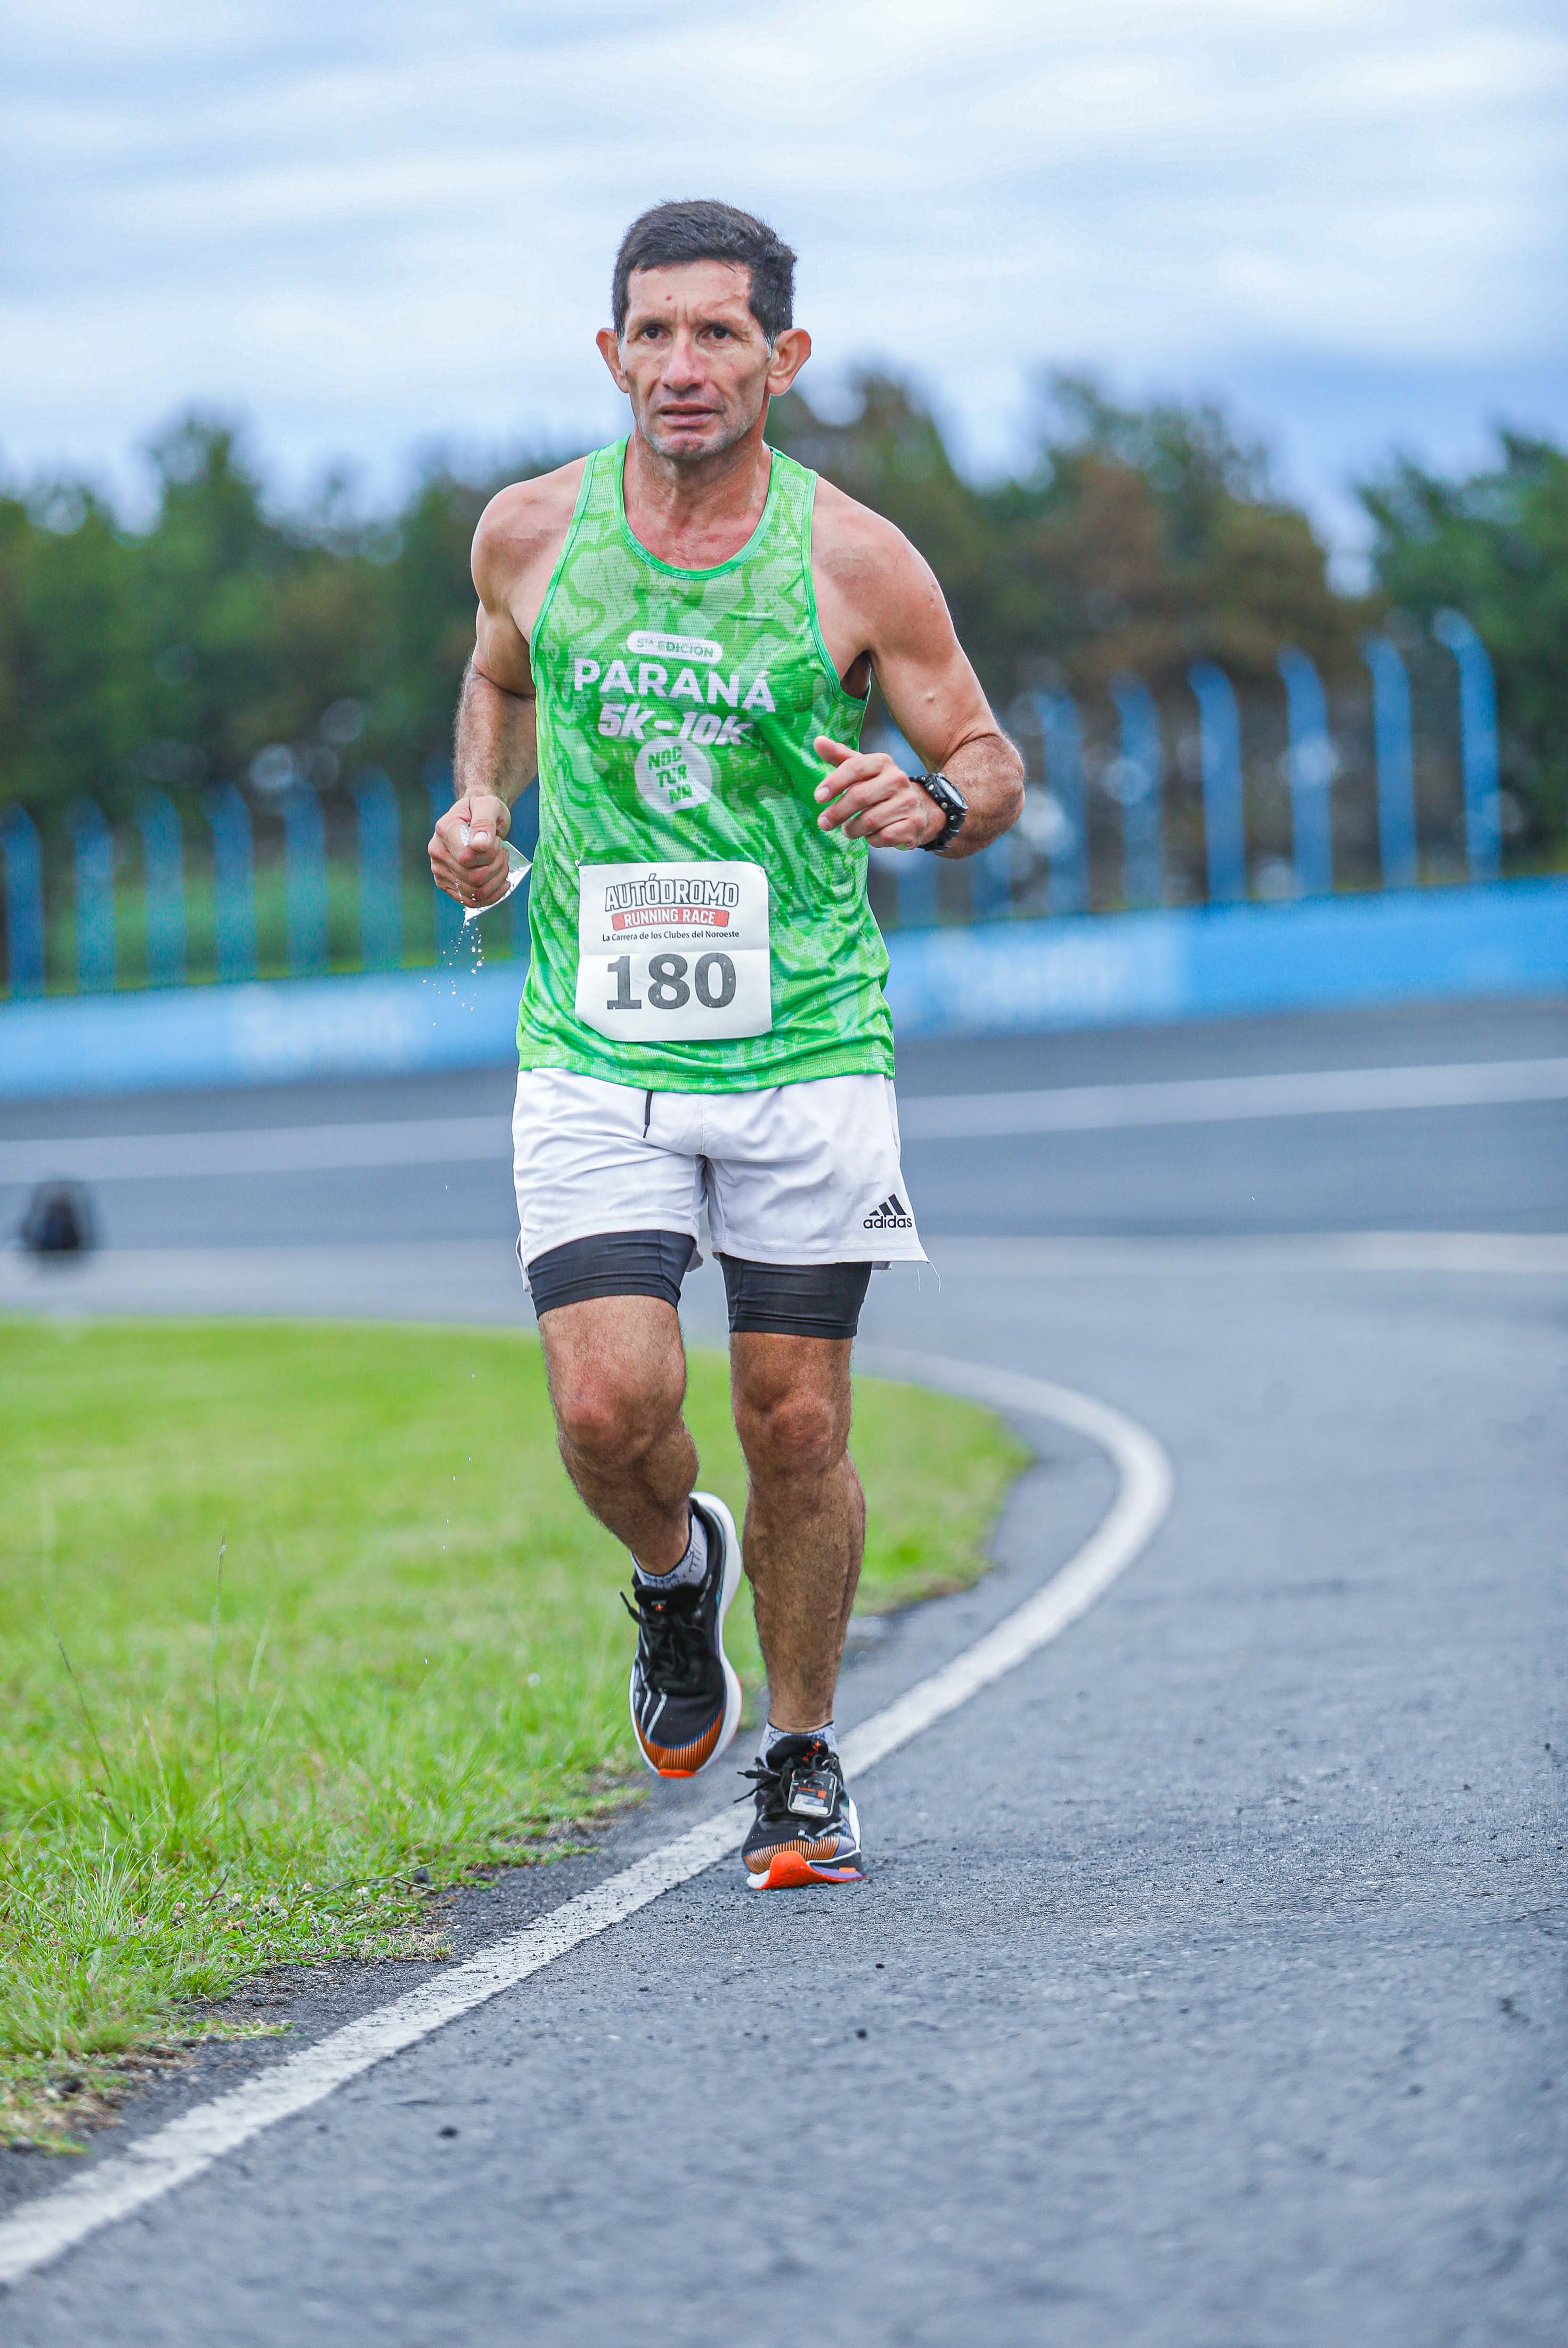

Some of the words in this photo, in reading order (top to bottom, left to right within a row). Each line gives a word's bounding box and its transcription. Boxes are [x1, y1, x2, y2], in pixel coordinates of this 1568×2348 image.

[657, 641, 713, 657] EDICIÓN
[574, 657, 776, 712] PARANÁ
[648, 745, 682, 770] NOC
[656, 763, 687, 787] TUR
[605, 873, 739, 912] AUTÓDROMO
[623, 908, 678, 927] RUNNING
[683, 908, 716, 924] RACE
[651, 931, 662, 939] los
[664, 930, 689, 939] Clubes
[705, 930, 740, 938] Noroeste
[607, 952, 736, 1010] 180
[863, 1215, 913, 1229] adidas
